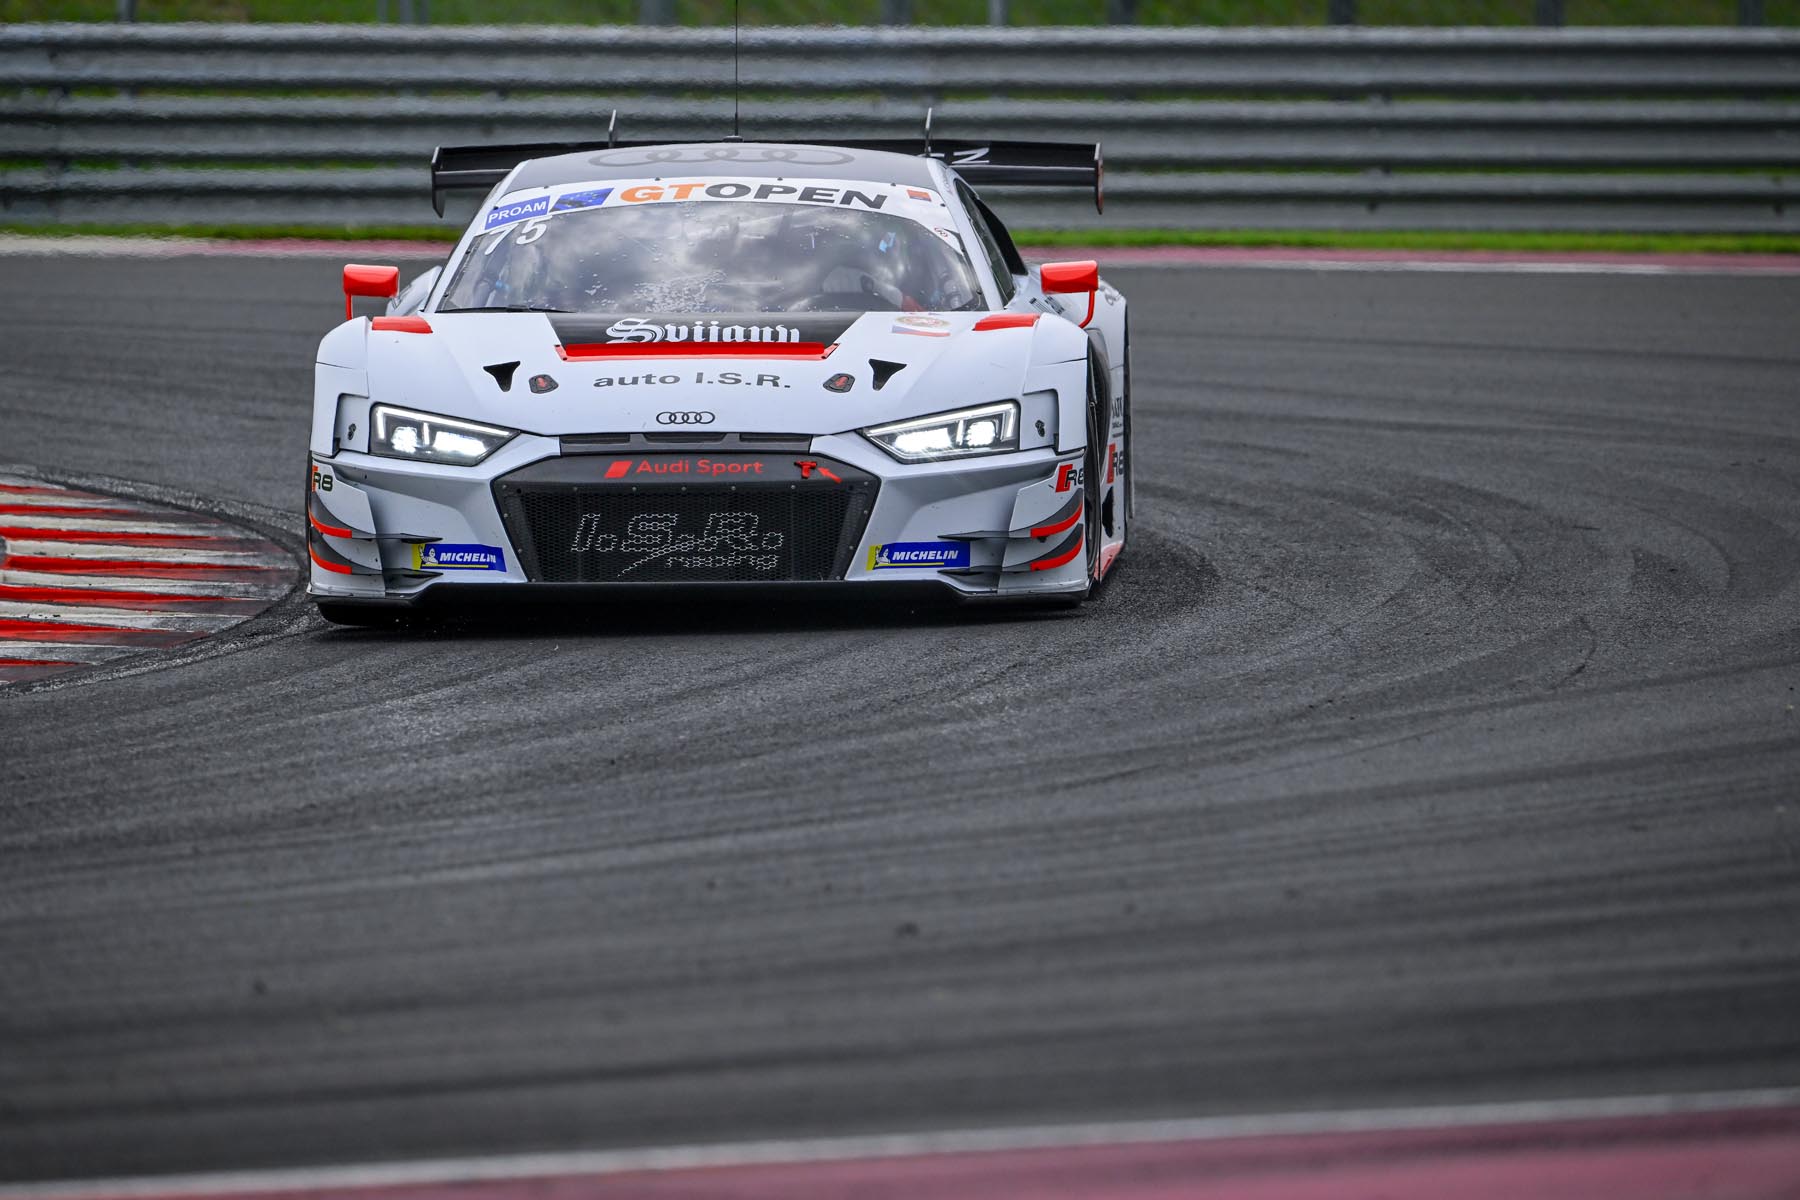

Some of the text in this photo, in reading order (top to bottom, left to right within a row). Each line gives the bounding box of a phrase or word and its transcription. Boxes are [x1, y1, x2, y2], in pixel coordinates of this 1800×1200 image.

[488, 201, 547, 224] PROAM
[484, 215, 552, 256] 75
[593, 372, 791, 389] auto I.S.R.
[636, 459, 763, 477] Audi Sport
[314, 472, 333, 492] R8
[439, 552, 496, 563] MICHELIN
[892, 550, 958, 560] MICHELIN
